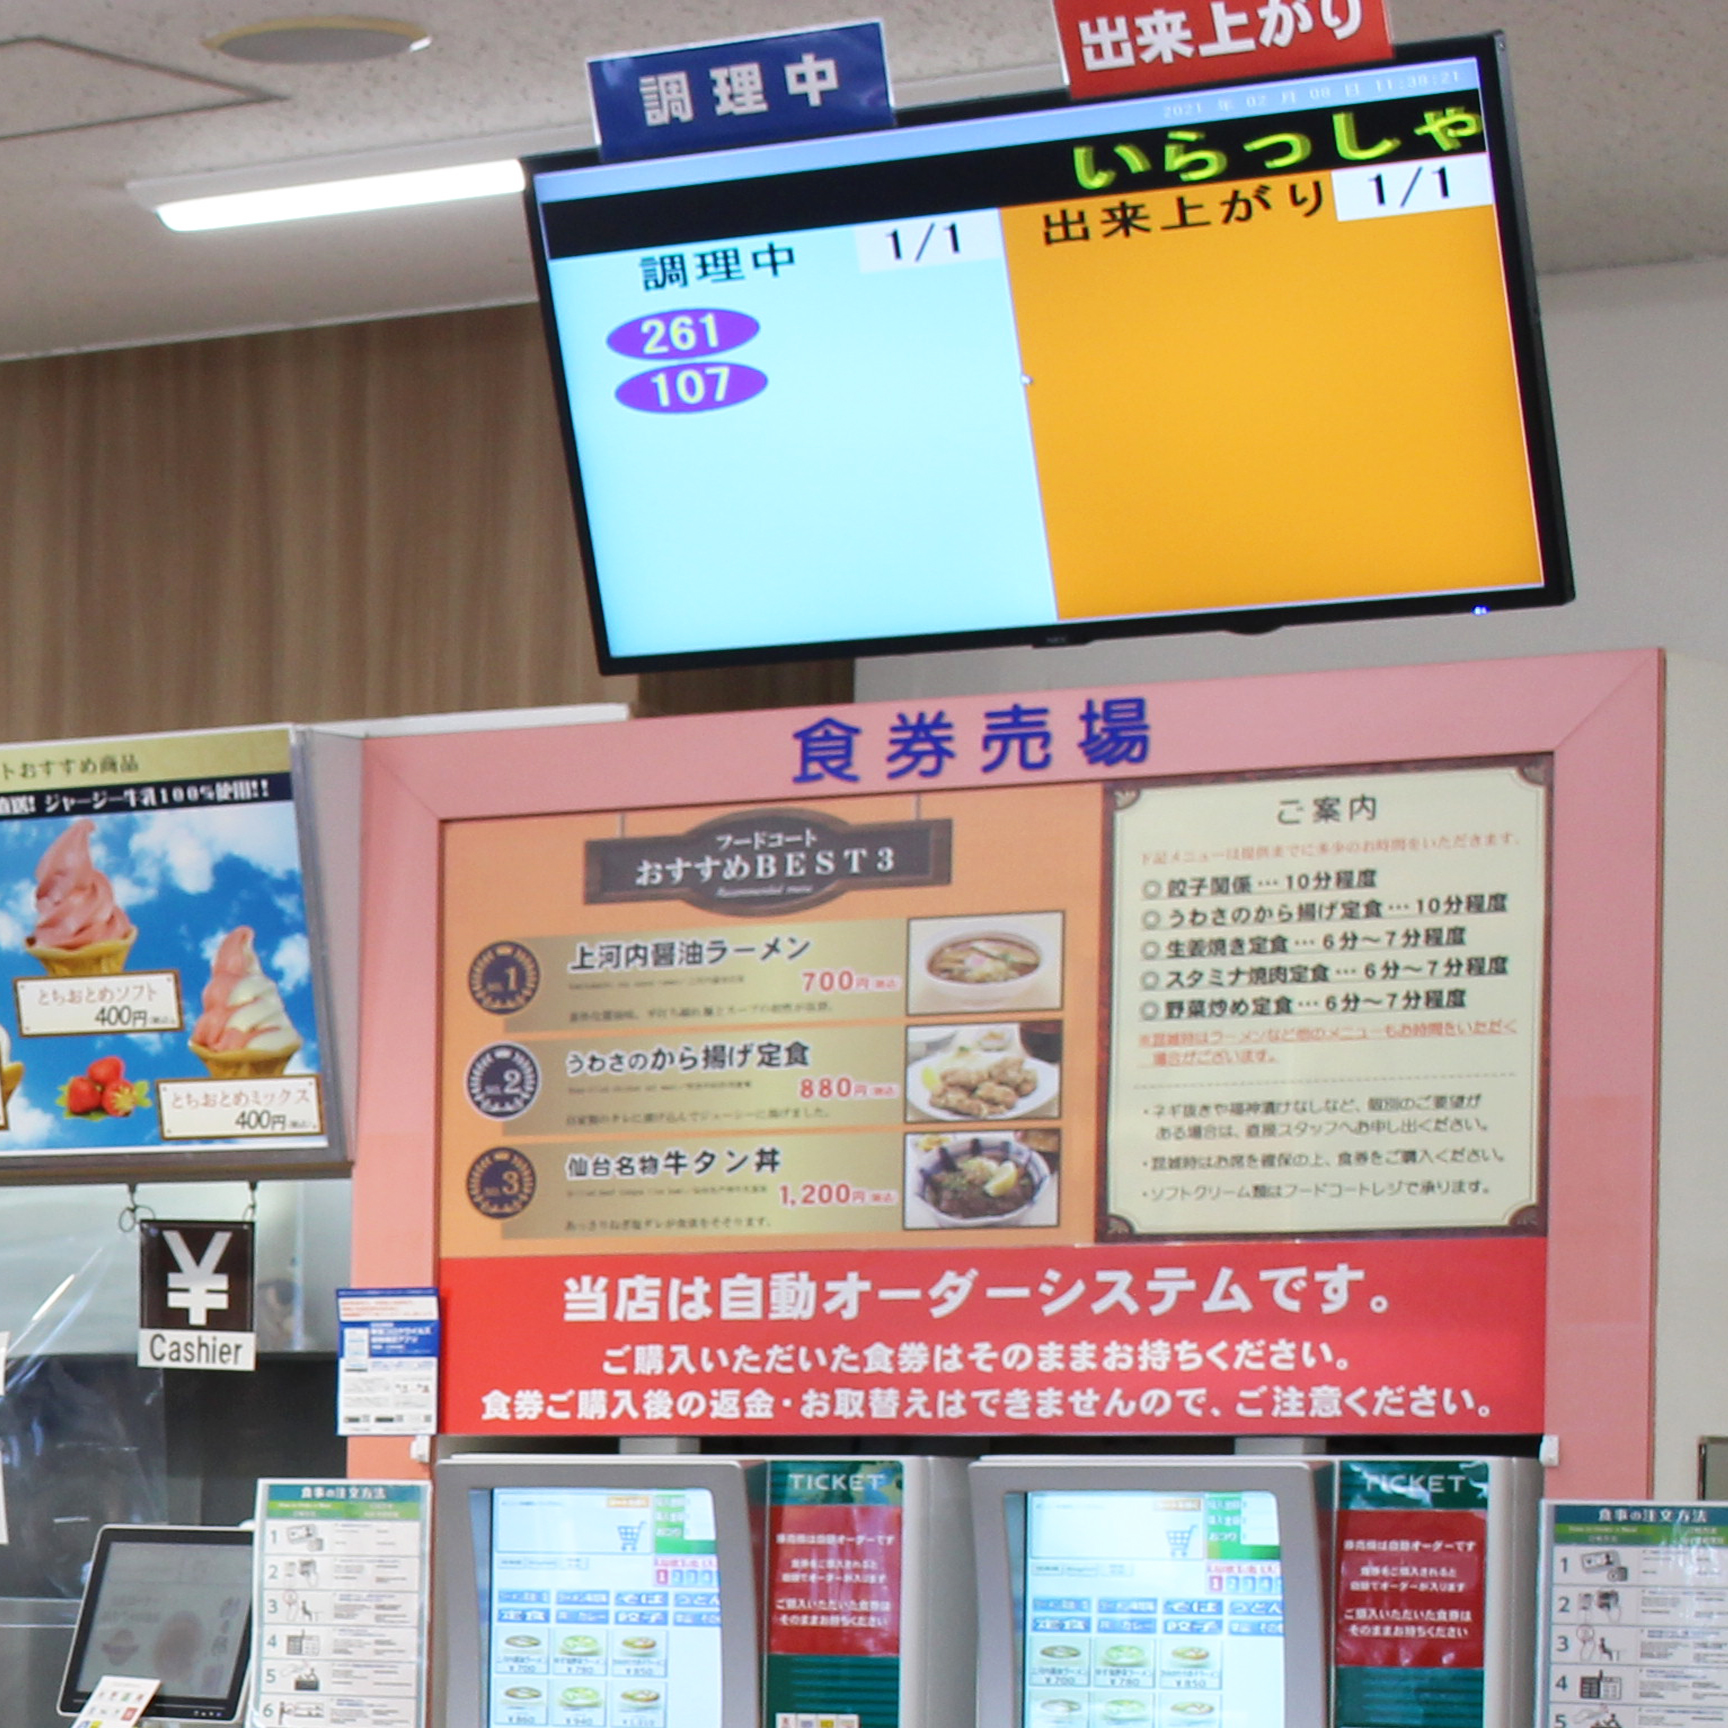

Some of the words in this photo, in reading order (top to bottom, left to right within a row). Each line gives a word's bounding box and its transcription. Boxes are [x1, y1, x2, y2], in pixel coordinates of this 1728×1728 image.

[1079, 0, 1364, 72] 出来上がり
[639, 53, 840, 127] 調理中
[1073, 106, 1483, 190] いらっしゃ
[1043, 180, 1325, 247] 出来上がり
[1367, 165, 1451, 208] 1/1
[638, 241, 796, 292] 調理中
[886, 222, 961, 263] 1/1
[640, 312, 721, 355] 261
[650, 366, 731, 408] 107
[792, 695, 1150, 785] 食券売場
[1276, 794, 1379, 826] ご案内
[715, 827, 818, 851] フードコート
[570, 937, 811, 971] 上河内醤油ラーメン
[802, 970, 871, 994] 700円
[567, 1040, 811, 1075] うわさのから揚げ定食
[799, 1077, 868, 1100] 880円
[567, 1147, 782, 1180] 仙台名物牛タン丼
[561, 1261, 1393, 1324] 当店は自動オーダーシステムです。
[149, 1332, 243, 1366] Cashier
[602, 1337, 1351, 1379] ご購入いただいた食券はそのままお持ちください。
[481, 1383, 1494, 1422] 食券ご購入後の返金・お取替えはできませんので、ご注意ください。
[300, 1484, 388, 1501] 食事の注文方法
[788, 1473, 888, 1492] TICKET
[1597, 1507, 1710, 1524] 食事の注文方法
[270, 1529, 278, 1544] 1
[268, 1564, 280, 1580] 2
[1558, 1556, 1569, 1574] 1
[268, 1600, 279, 1617] 3
[1558, 1596, 1571, 1613] 2
[267, 1633, 279, 1649] 4
[1556, 1635, 1570, 1653] 3
[265, 1667, 277, 1684] 5
[1554, 1675, 1569, 1692] 4
[262, 1701, 274, 1719] 6
